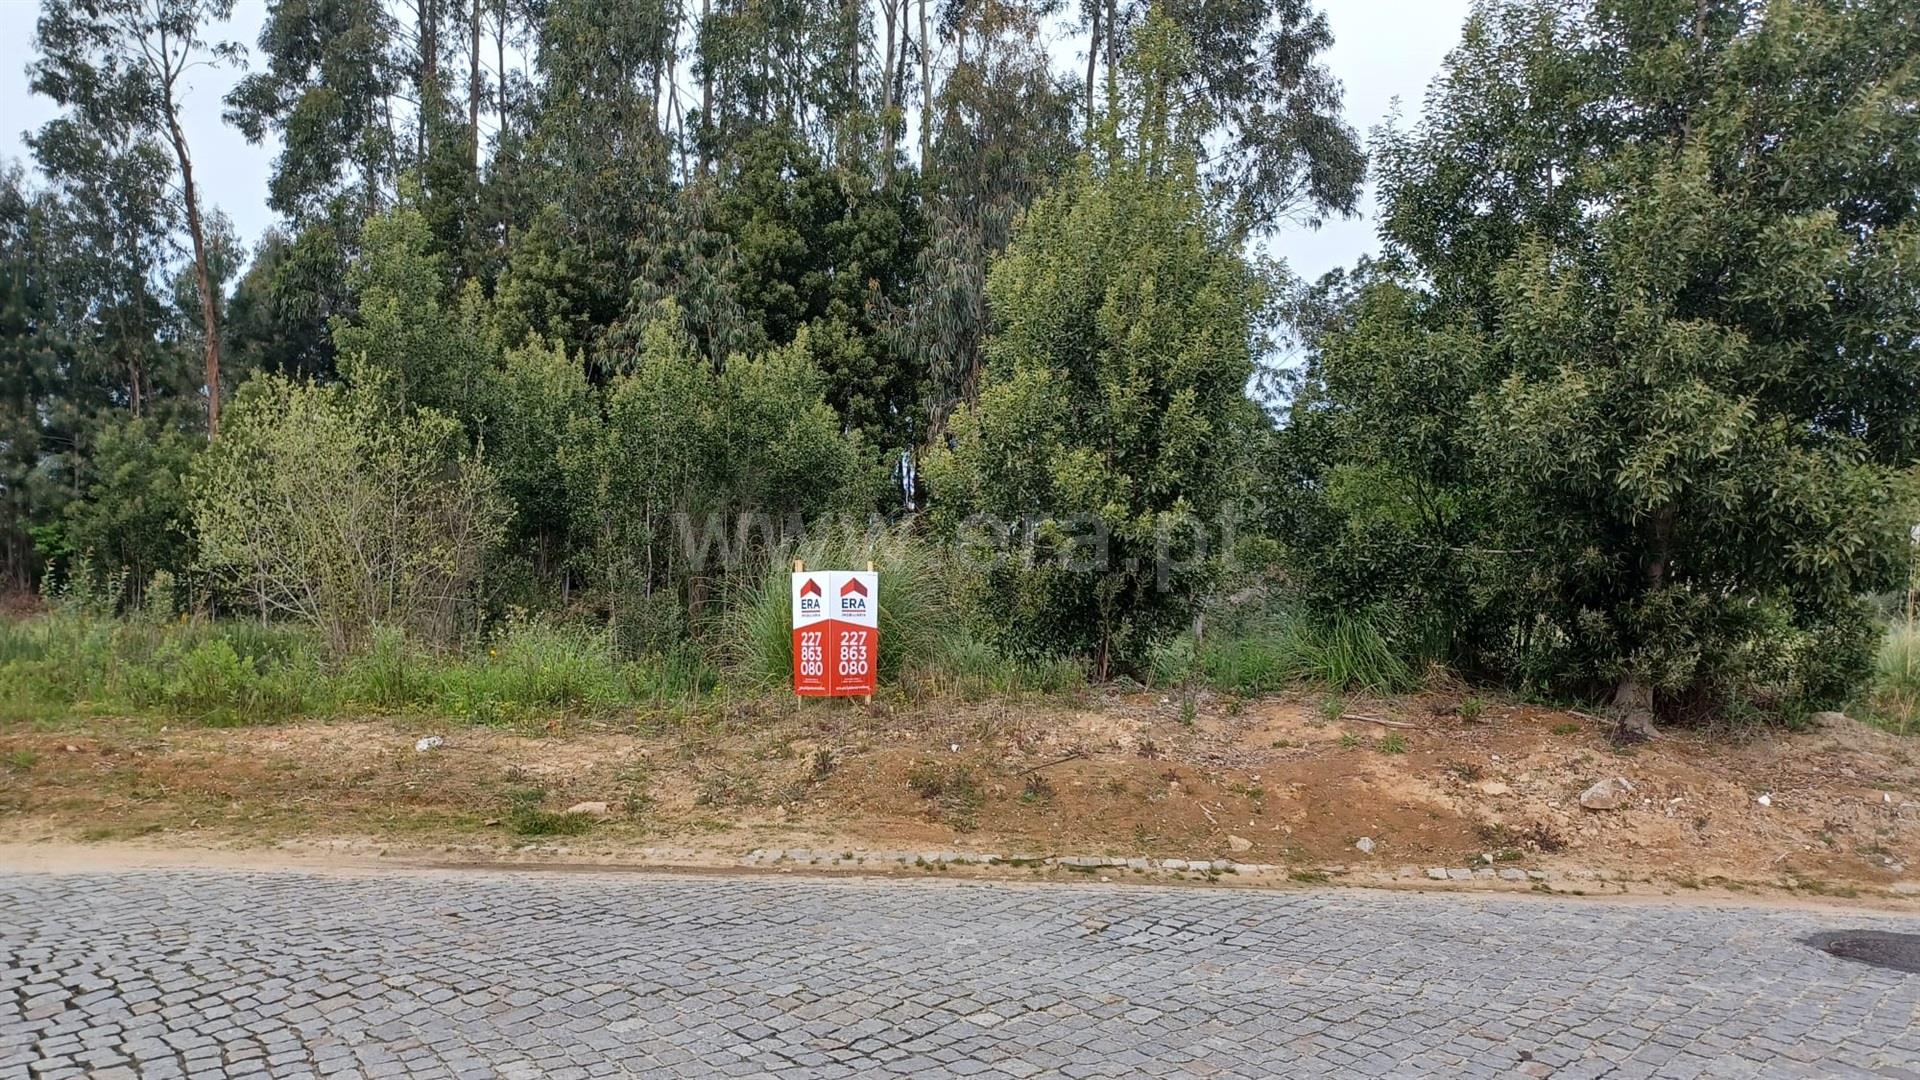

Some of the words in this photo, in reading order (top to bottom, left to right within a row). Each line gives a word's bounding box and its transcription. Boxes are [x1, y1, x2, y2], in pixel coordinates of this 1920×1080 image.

[801, 598, 820, 609] ERA
[841, 598, 866, 609] ERA
[801, 632, 822, 646] 227
[840, 631, 867, 645] 227
[801, 646, 822, 660] 863
[840, 646, 867, 660] 863
[801, 661, 823, 676] 080
[839, 661, 868, 675] 080
